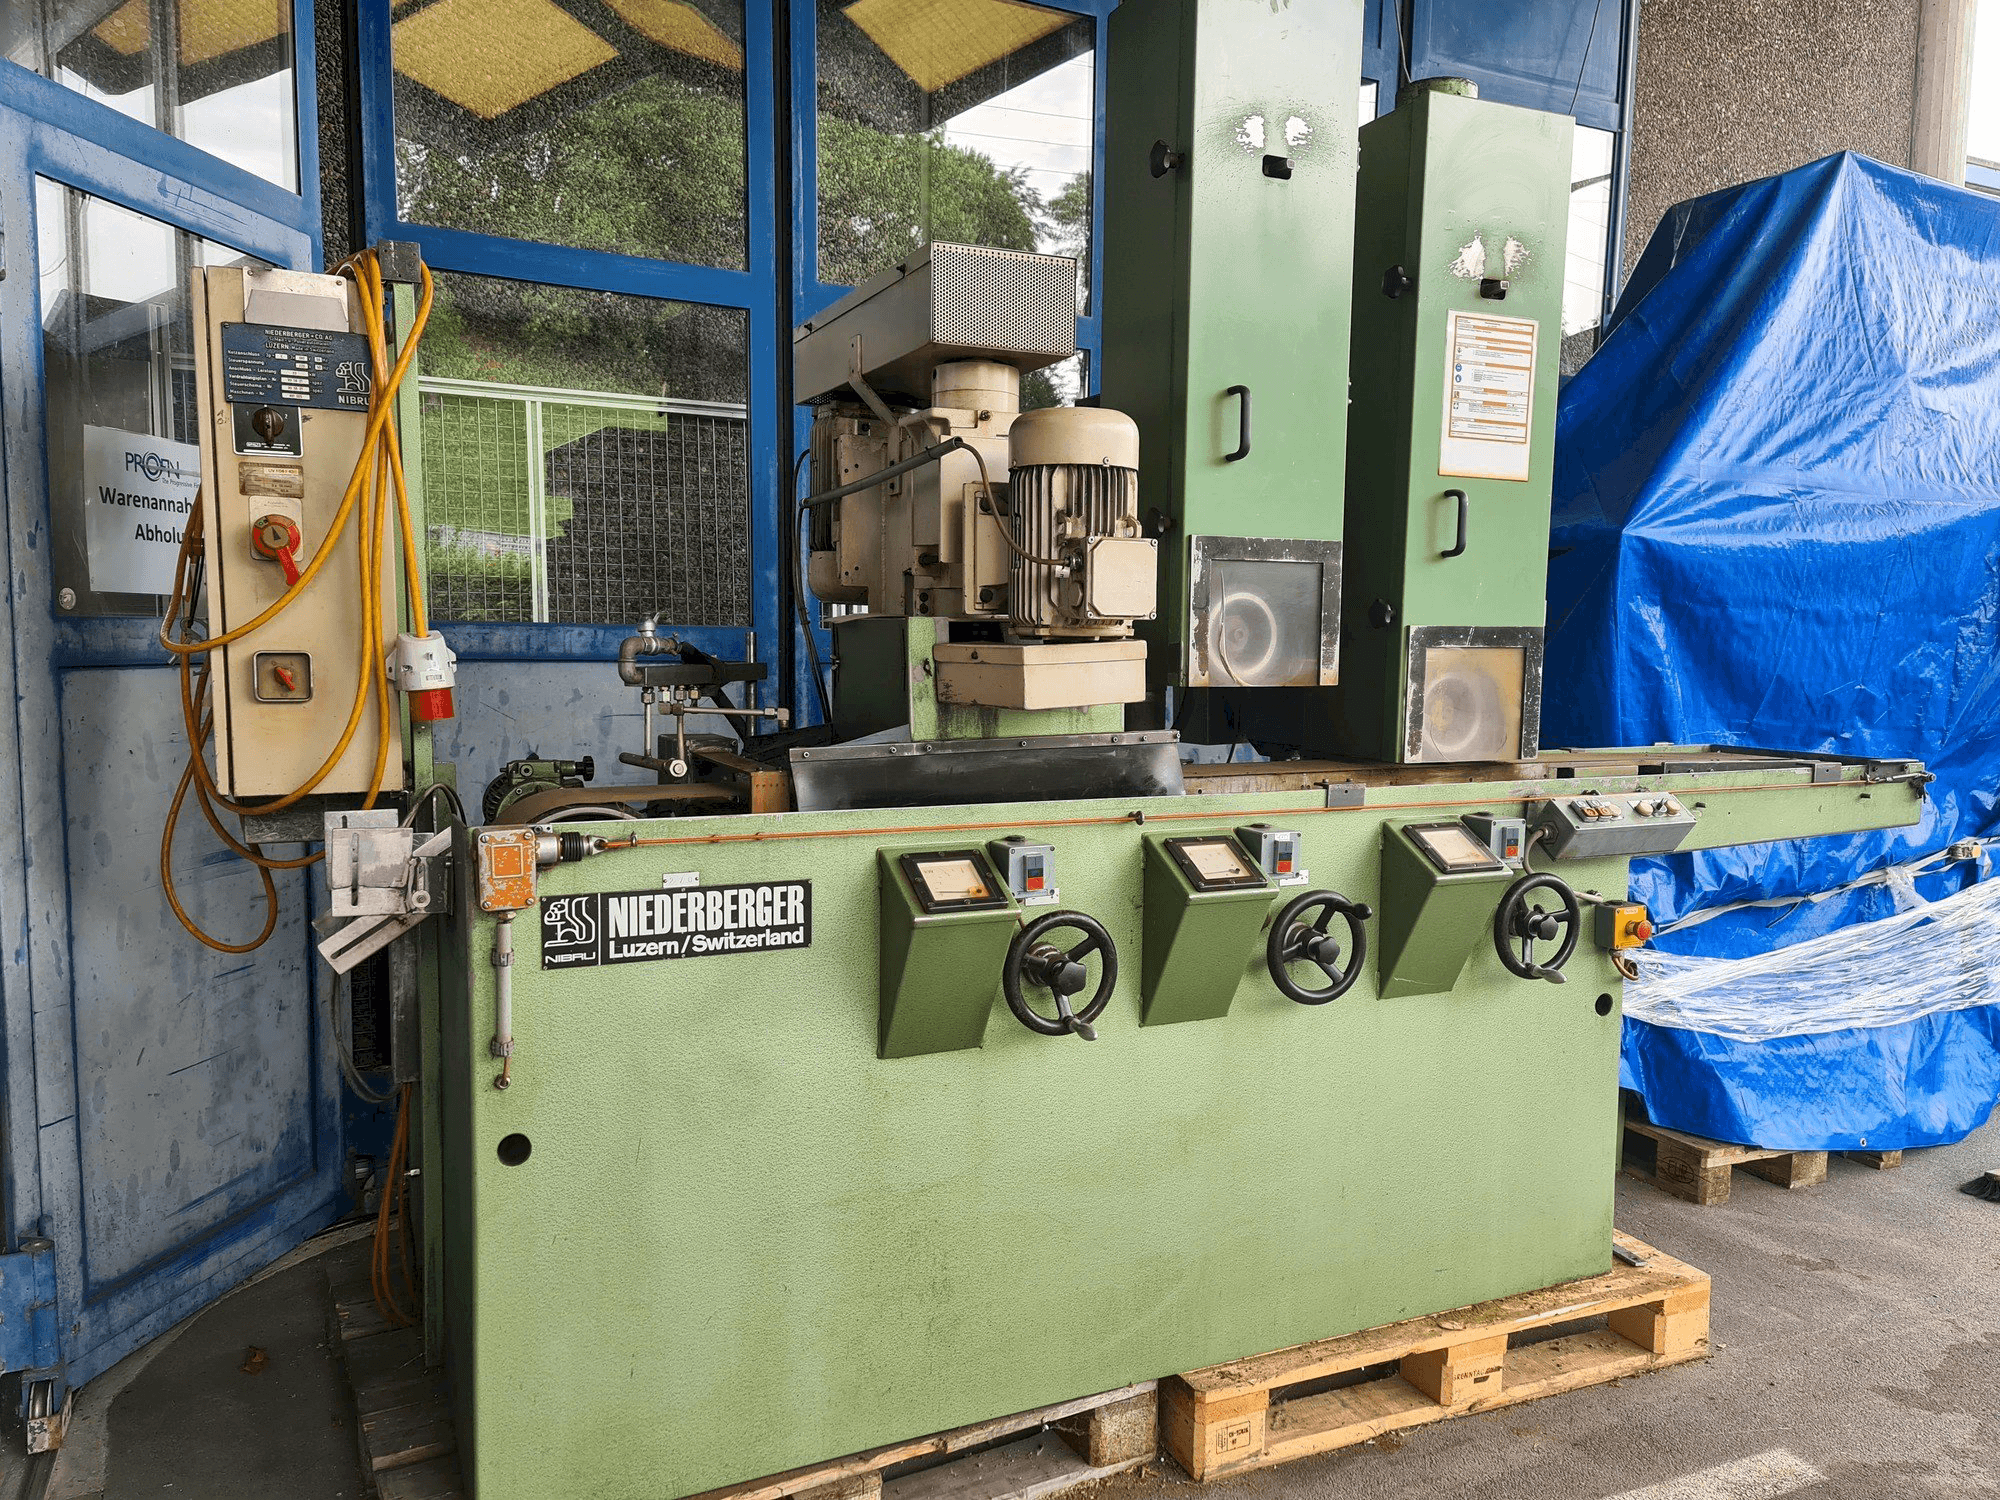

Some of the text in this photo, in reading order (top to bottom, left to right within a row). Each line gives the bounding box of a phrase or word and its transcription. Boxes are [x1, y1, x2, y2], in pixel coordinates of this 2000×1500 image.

[265, 329, 310, 339] NIEDERBERGER
[265, 341, 289, 350] LUZERN
[609, 885, 805, 939] NIEDERBERGER
[545, 951, 596, 964] NIBRU
